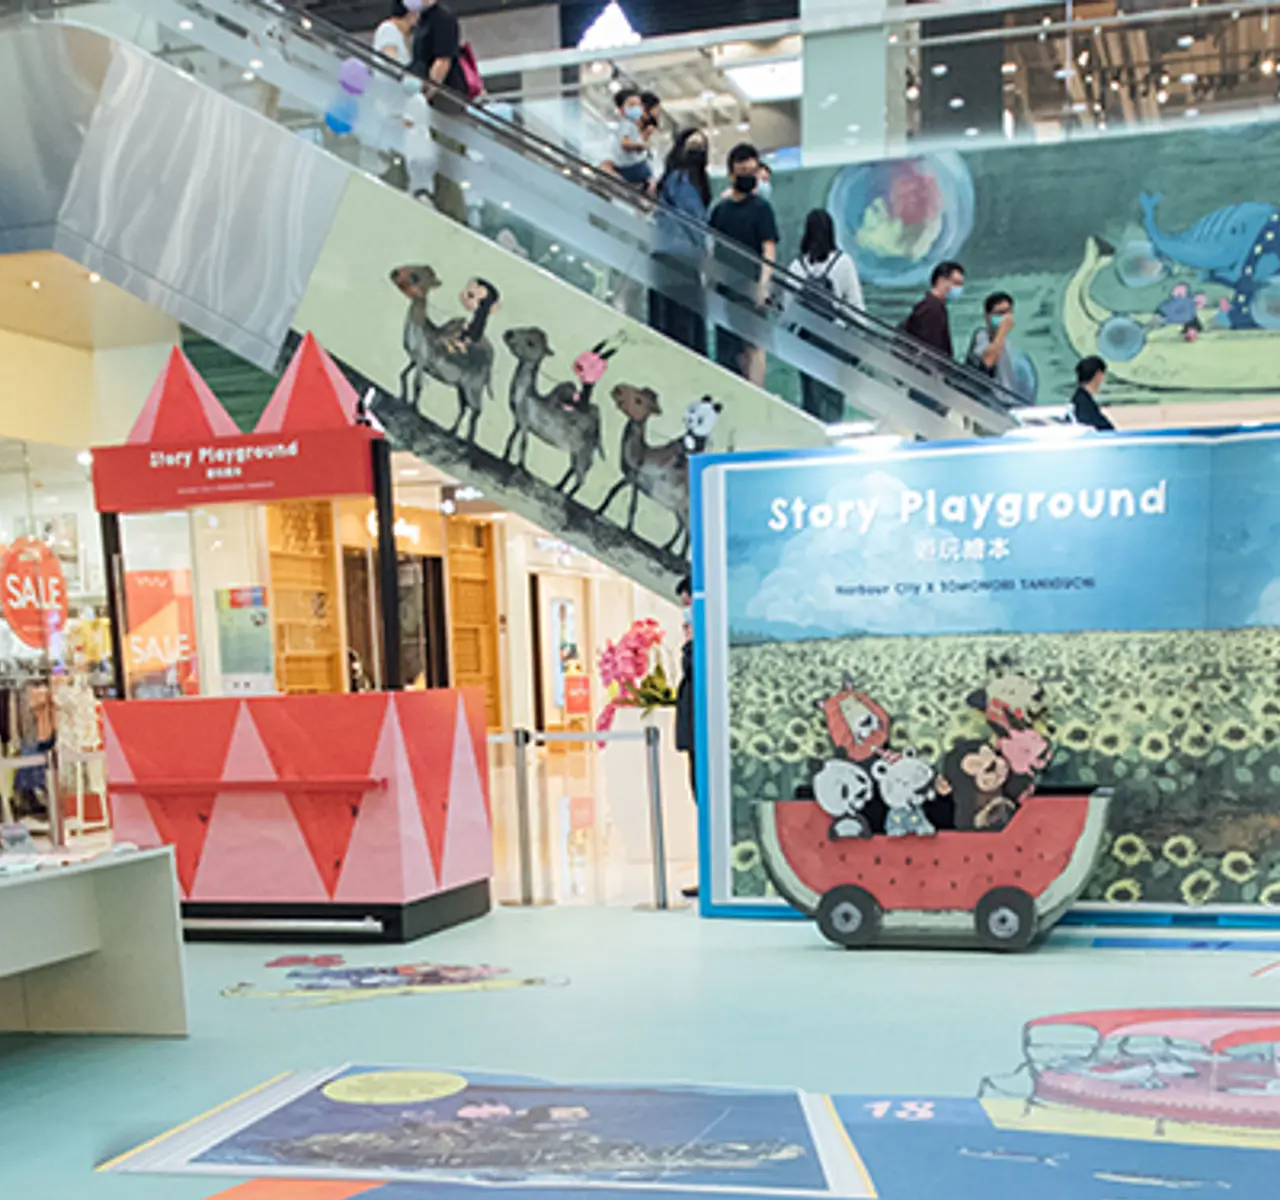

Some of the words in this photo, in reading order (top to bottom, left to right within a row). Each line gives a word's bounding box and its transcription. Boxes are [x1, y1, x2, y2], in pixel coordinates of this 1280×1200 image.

[149, 449, 192, 468] Story
[198, 440, 299, 465] Playground
[767, 495, 879, 534] Story
[900, 480, 1168, 530] Playground
[5, 573, 62, 610] SALE
[834, 583, 889, 597] Harbour
[894, 581, 921, 597] City
[130, 633, 191, 664] SALE
[863, 1100, 935, 1120] 18
